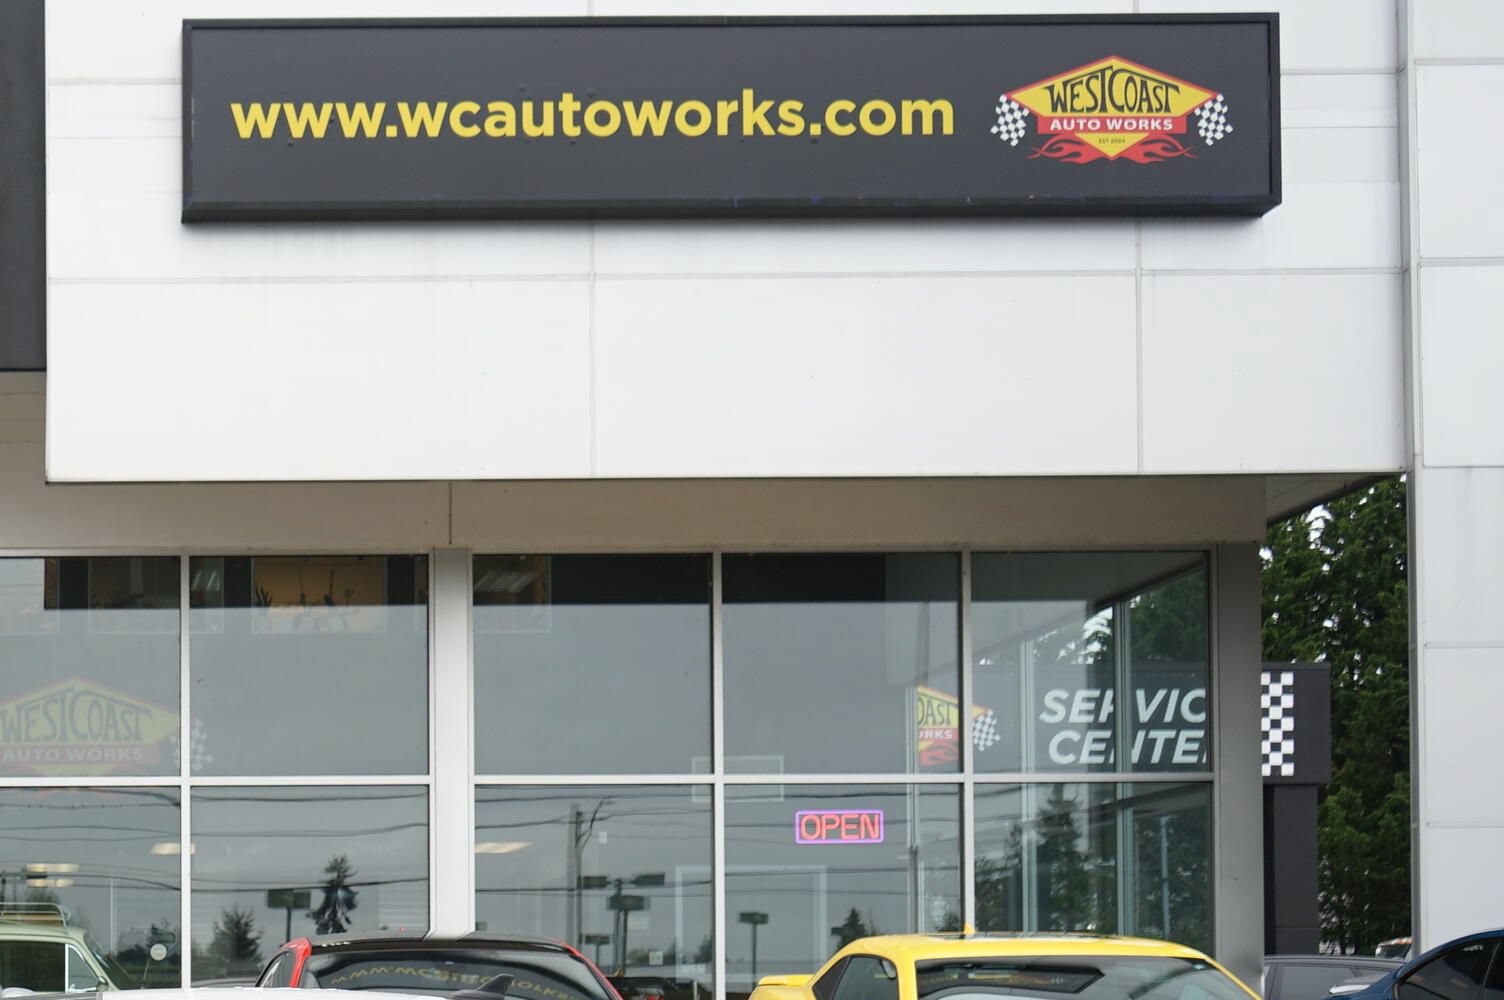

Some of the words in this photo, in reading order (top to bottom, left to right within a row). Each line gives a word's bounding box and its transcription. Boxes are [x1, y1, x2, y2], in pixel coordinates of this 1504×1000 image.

[231, 89, 954, 138] www.wcautoworks.com
[1050, 118, 1101, 130] AUTO
[1106, 118, 1173, 130] WORKS
[2, 749, 55, 762] AUTO
[60, 749, 143, 761] WORKS
[1048, 729, 1207, 764] CETE
[800, 813, 880, 840] OPEN
